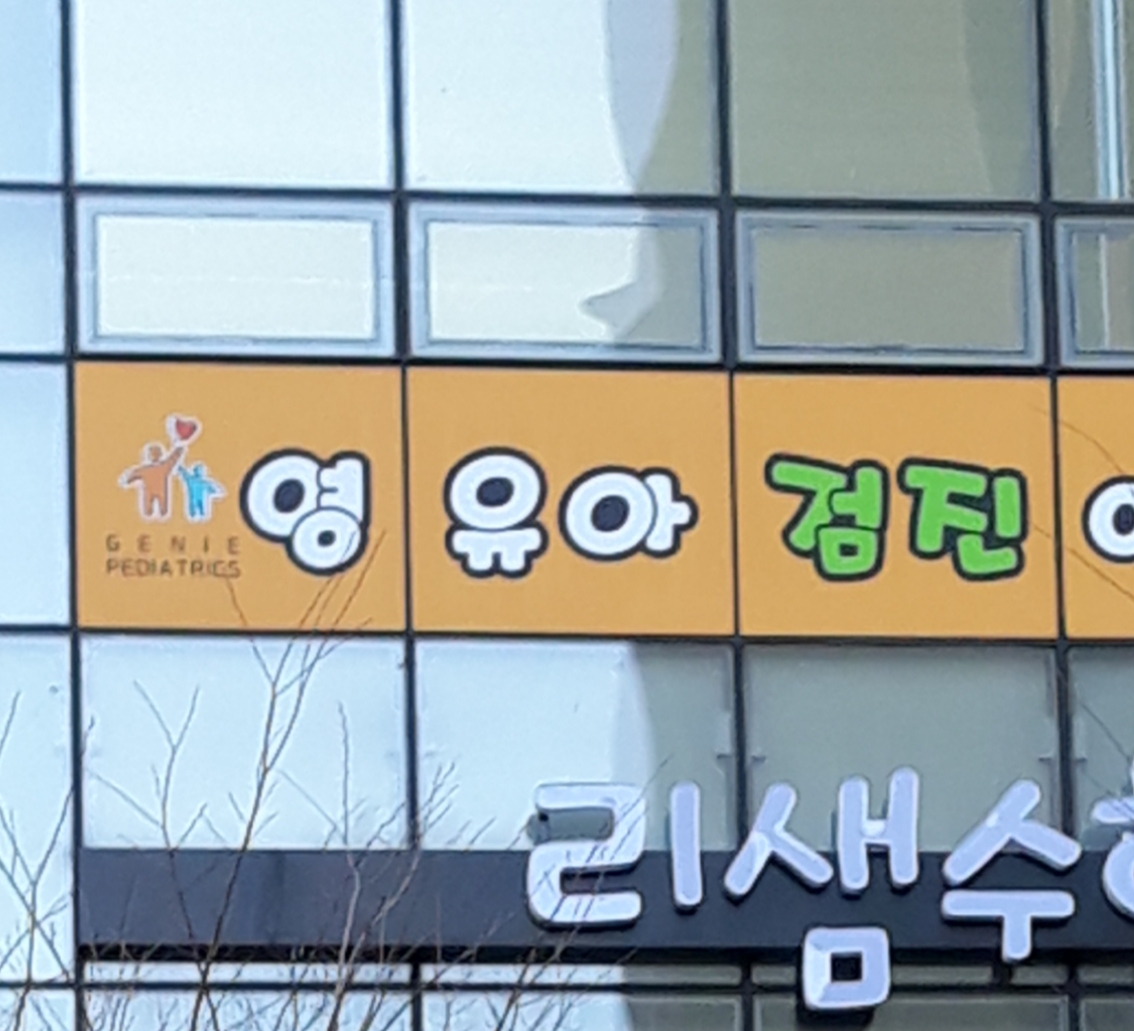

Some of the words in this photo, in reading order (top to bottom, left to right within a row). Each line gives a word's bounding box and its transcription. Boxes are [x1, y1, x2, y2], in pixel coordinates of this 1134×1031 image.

[764, 452, 1029, 581] 검진
[106, 534, 239, 555] GENIE
[106, 558, 241, 578] PEDIATRICS
